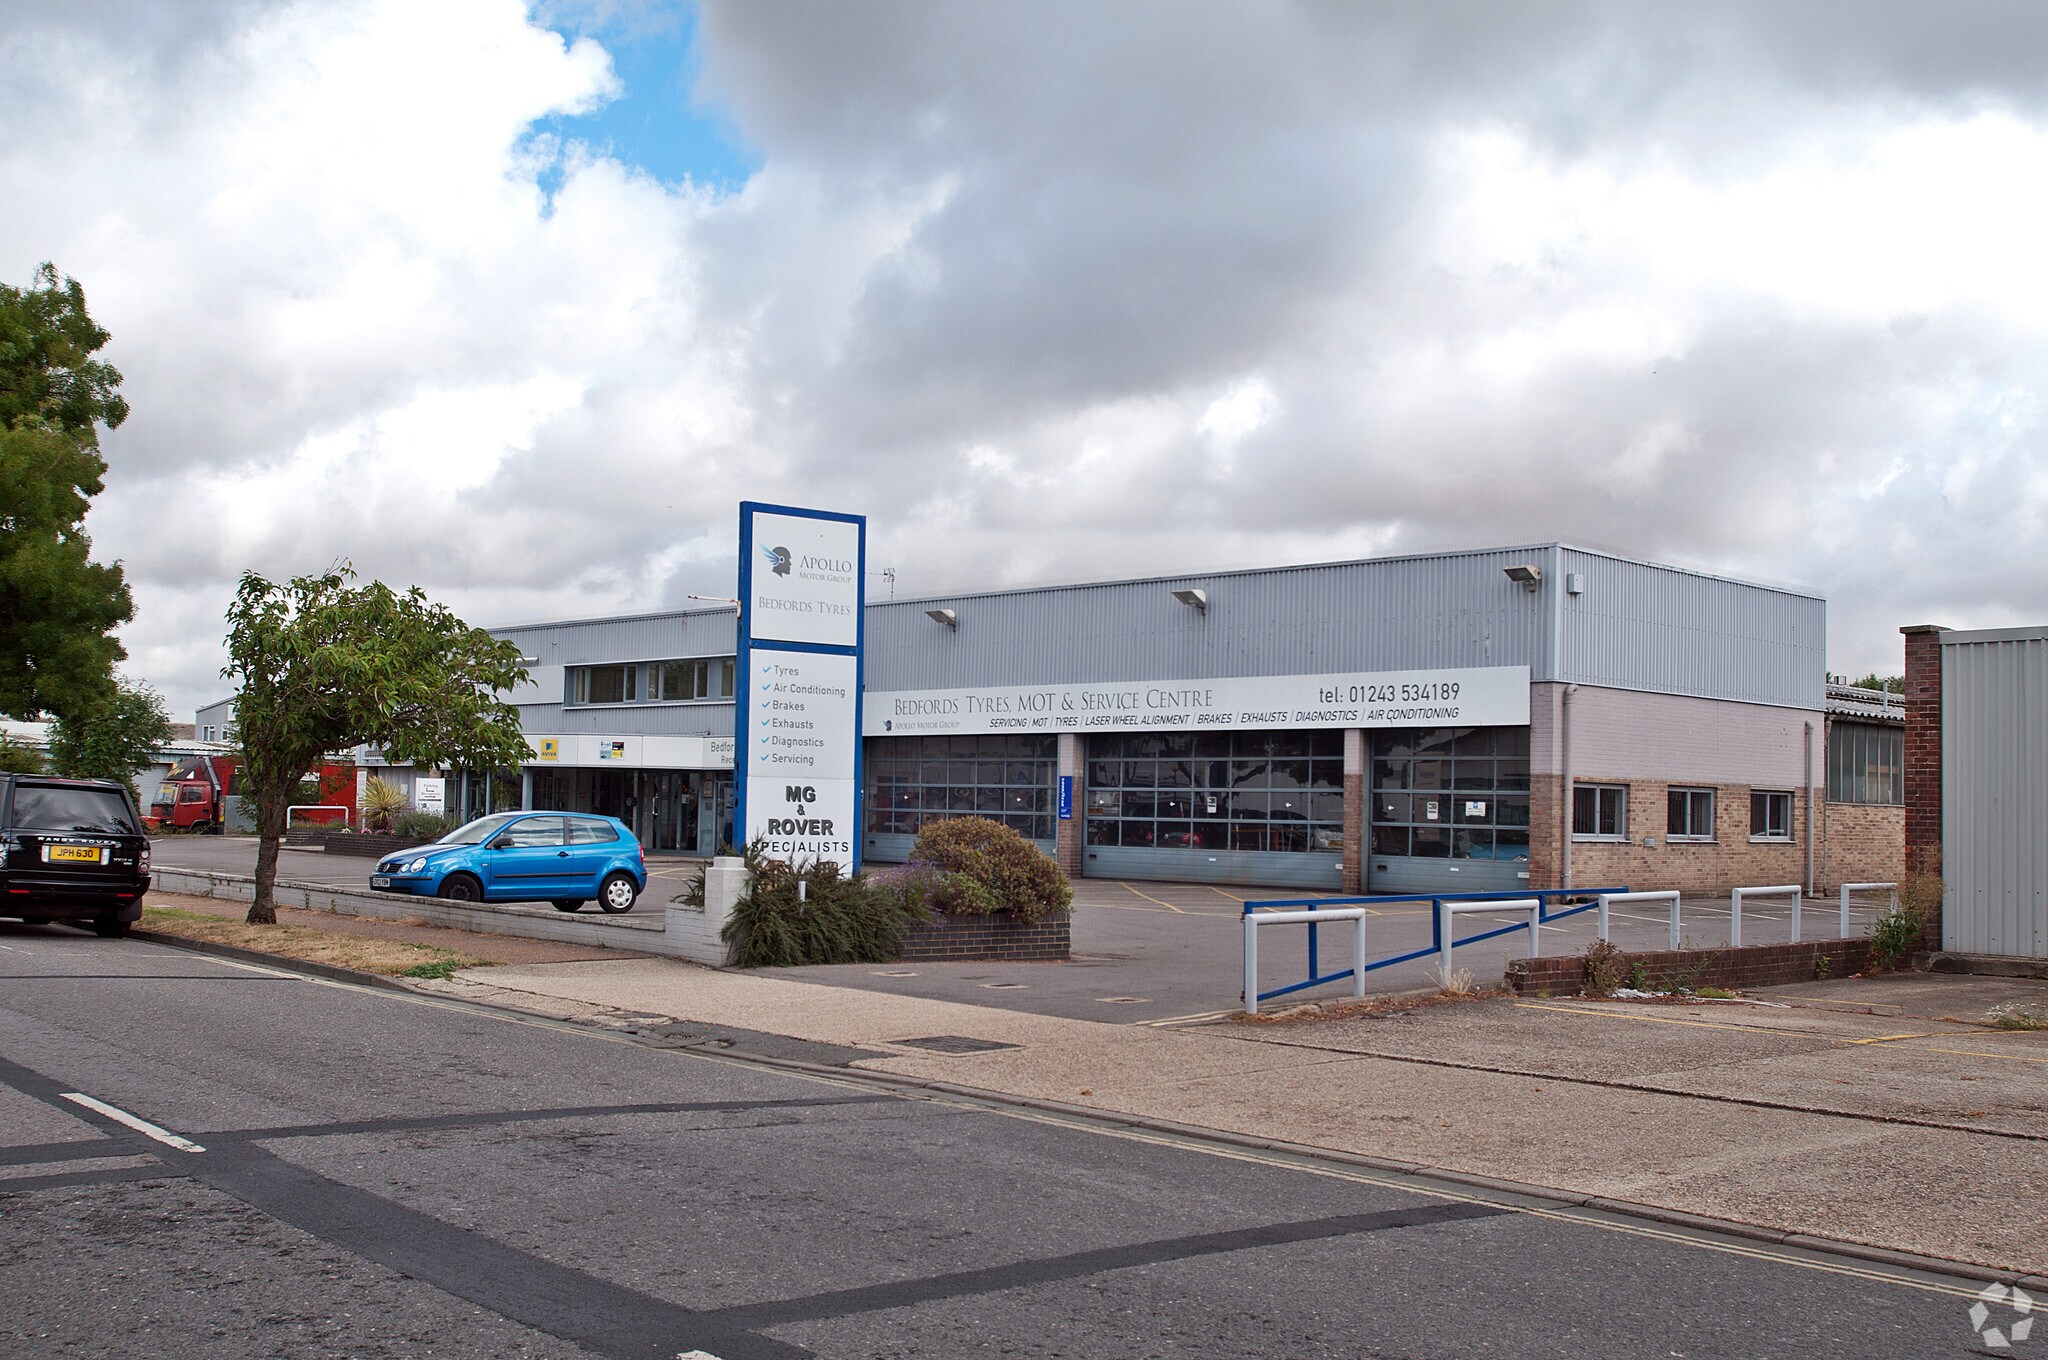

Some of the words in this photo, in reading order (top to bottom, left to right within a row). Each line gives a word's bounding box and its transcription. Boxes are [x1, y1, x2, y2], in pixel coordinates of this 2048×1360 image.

[799, 555, 852, 573] APOLLO
[799, 572, 826, 582] MOTOR
[827, 574, 852, 584] GROUP
[758, 596, 813, 613] BEDFORDS
[817, 601, 851, 616] TYRES
[774, 665, 799, 677] Tyres
[773, 683, 787, 694] Air
[790, 684, 846, 698] Conditioning
[1319, 687, 1344, 704] tel:
[1349, 685, 1396, 703] 01243
[1401, 682, 1460, 702] 534189
[772, 700, 805, 711] Brakes
[894, 698, 959, 716] BEDFORDS
[1017, 692, 1056, 712] MOT
[1061, 692, 1075, 711] &
[1081, 691, 1140, 711] SERVICE
[1146, 689, 1213, 709] CENTRE
[772, 718, 814, 730] Exhausts
[989, 717, 1028, 728] SERVICING
[1031, 717, 1048, 727] MOT
[1055, 716, 1078, 727] TYRES
[1085, 715, 1111, 726] LASER
[1112, 715, 1139, 725] WHEEL
[1140, 714, 1190, 725] ALIGNMENT
[1197, 712, 1233, 725] BRAKES
[1240, 711, 1288, 724] EXHAUSTS
[1295, 710, 1358, 723] DIAGNOSTICS
[1367, 708, 1384, 721] AIR
[1386, 707, 1460, 721] CONDITIONING
[894, 721, 916, 730] APOLLO
[917, 721, 939, 730] MOTOR
[939, 720, 960, 729] GROUP
[771, 735, 824, 748] Diagnostics
[771, 753, 814, 766] Servicing
[785, 785, 817, 803] MG
[796, 804, 806, 816] &
[767, 818, 834, 836] ROVER
[57, 848, 74, 858] JPH
[76, 849, 94, 858] 630
[751, 841, 849, 853] SPECIALISTS
